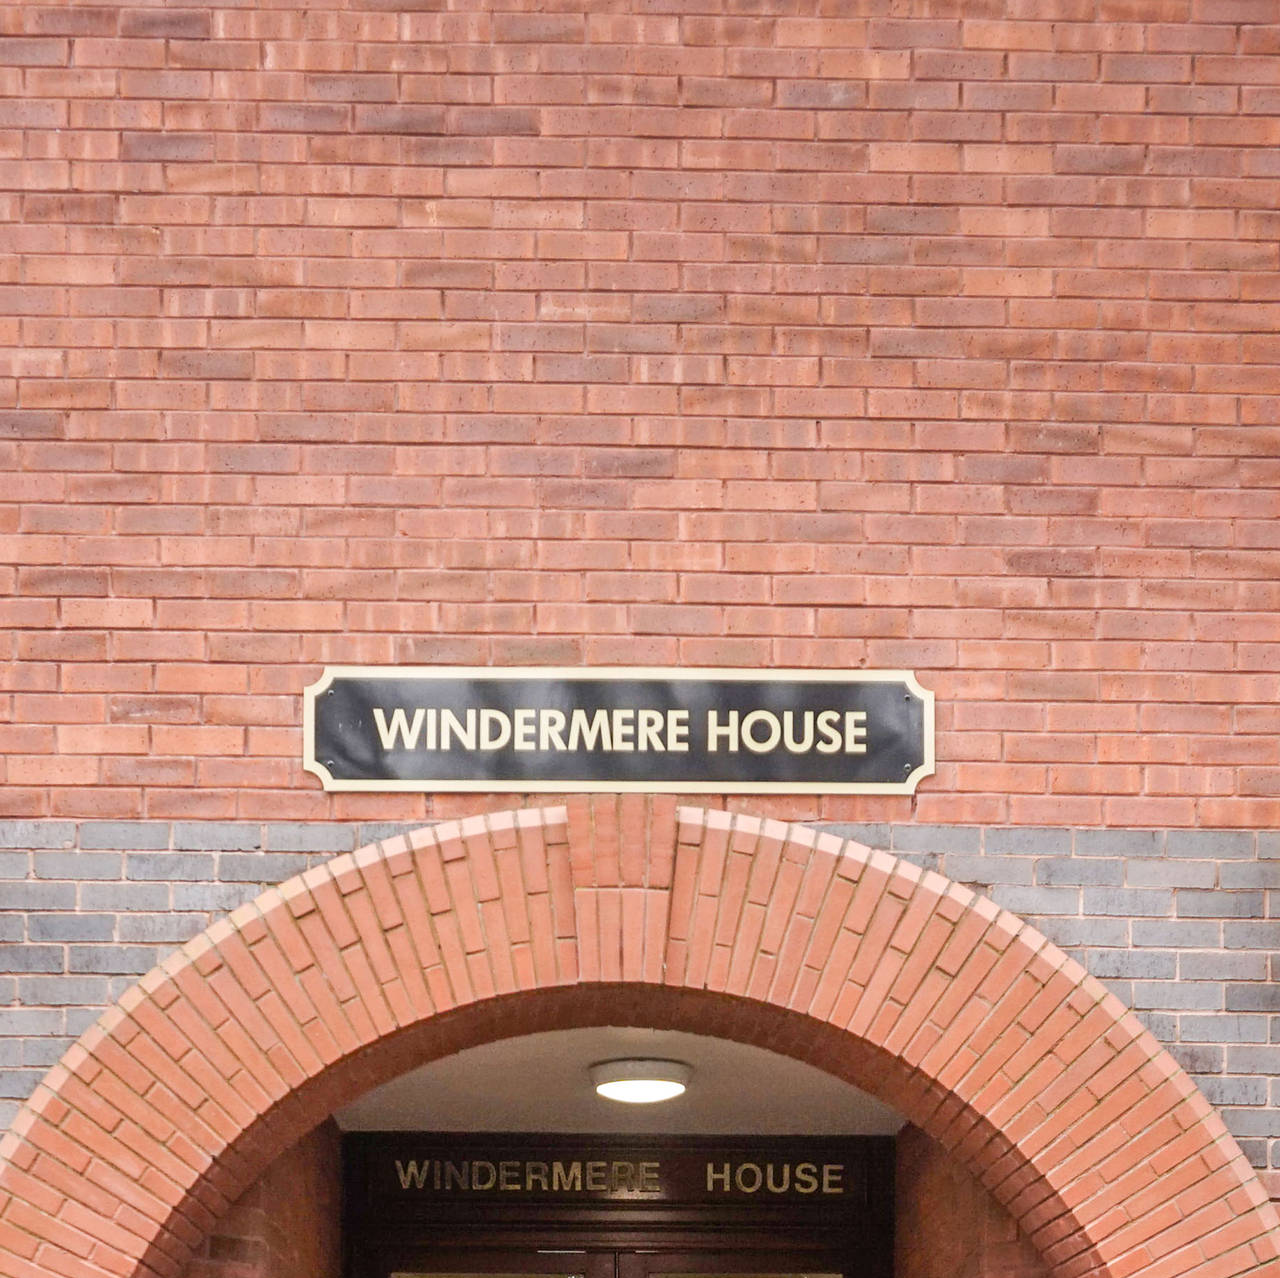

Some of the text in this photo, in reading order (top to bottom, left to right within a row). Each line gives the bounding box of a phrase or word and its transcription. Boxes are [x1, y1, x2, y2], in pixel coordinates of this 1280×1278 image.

[373, 707, 867, 754] WINDERMERE HOUSE
[394, 1160, 844, 1194] WINDERMERE HOUSE
